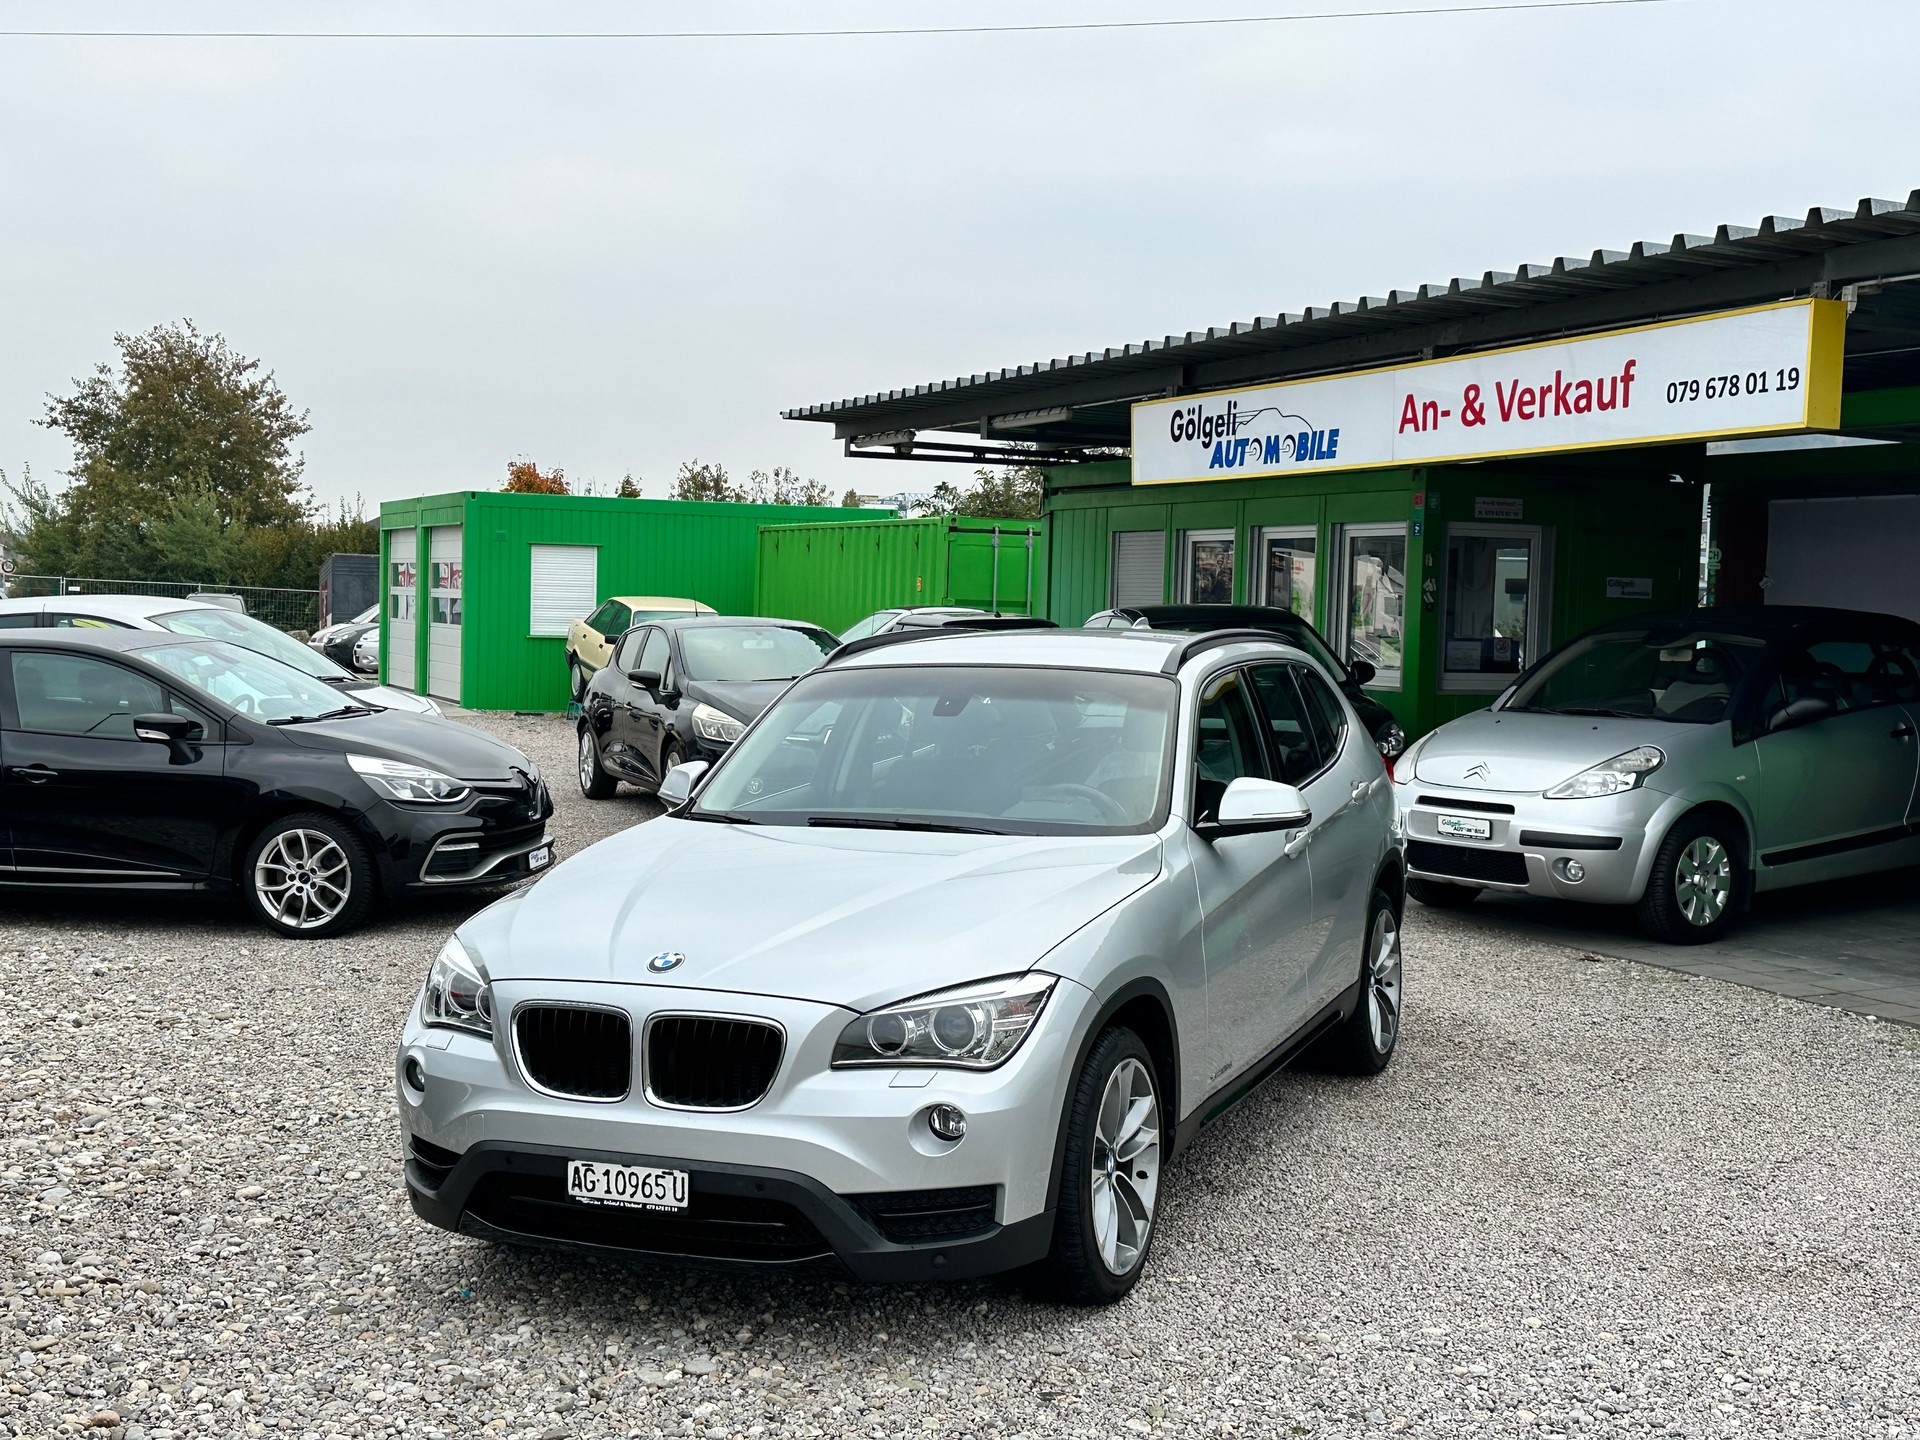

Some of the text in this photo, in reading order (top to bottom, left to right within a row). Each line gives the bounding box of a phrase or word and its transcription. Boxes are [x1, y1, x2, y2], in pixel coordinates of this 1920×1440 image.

[1399, 359, 1800, 434] An- & Verkauf 079 678 01 19
[1170, 400, 1238, 449] Gölgeli
[1209, 428, 1340, 469] AUTOMOBILE
